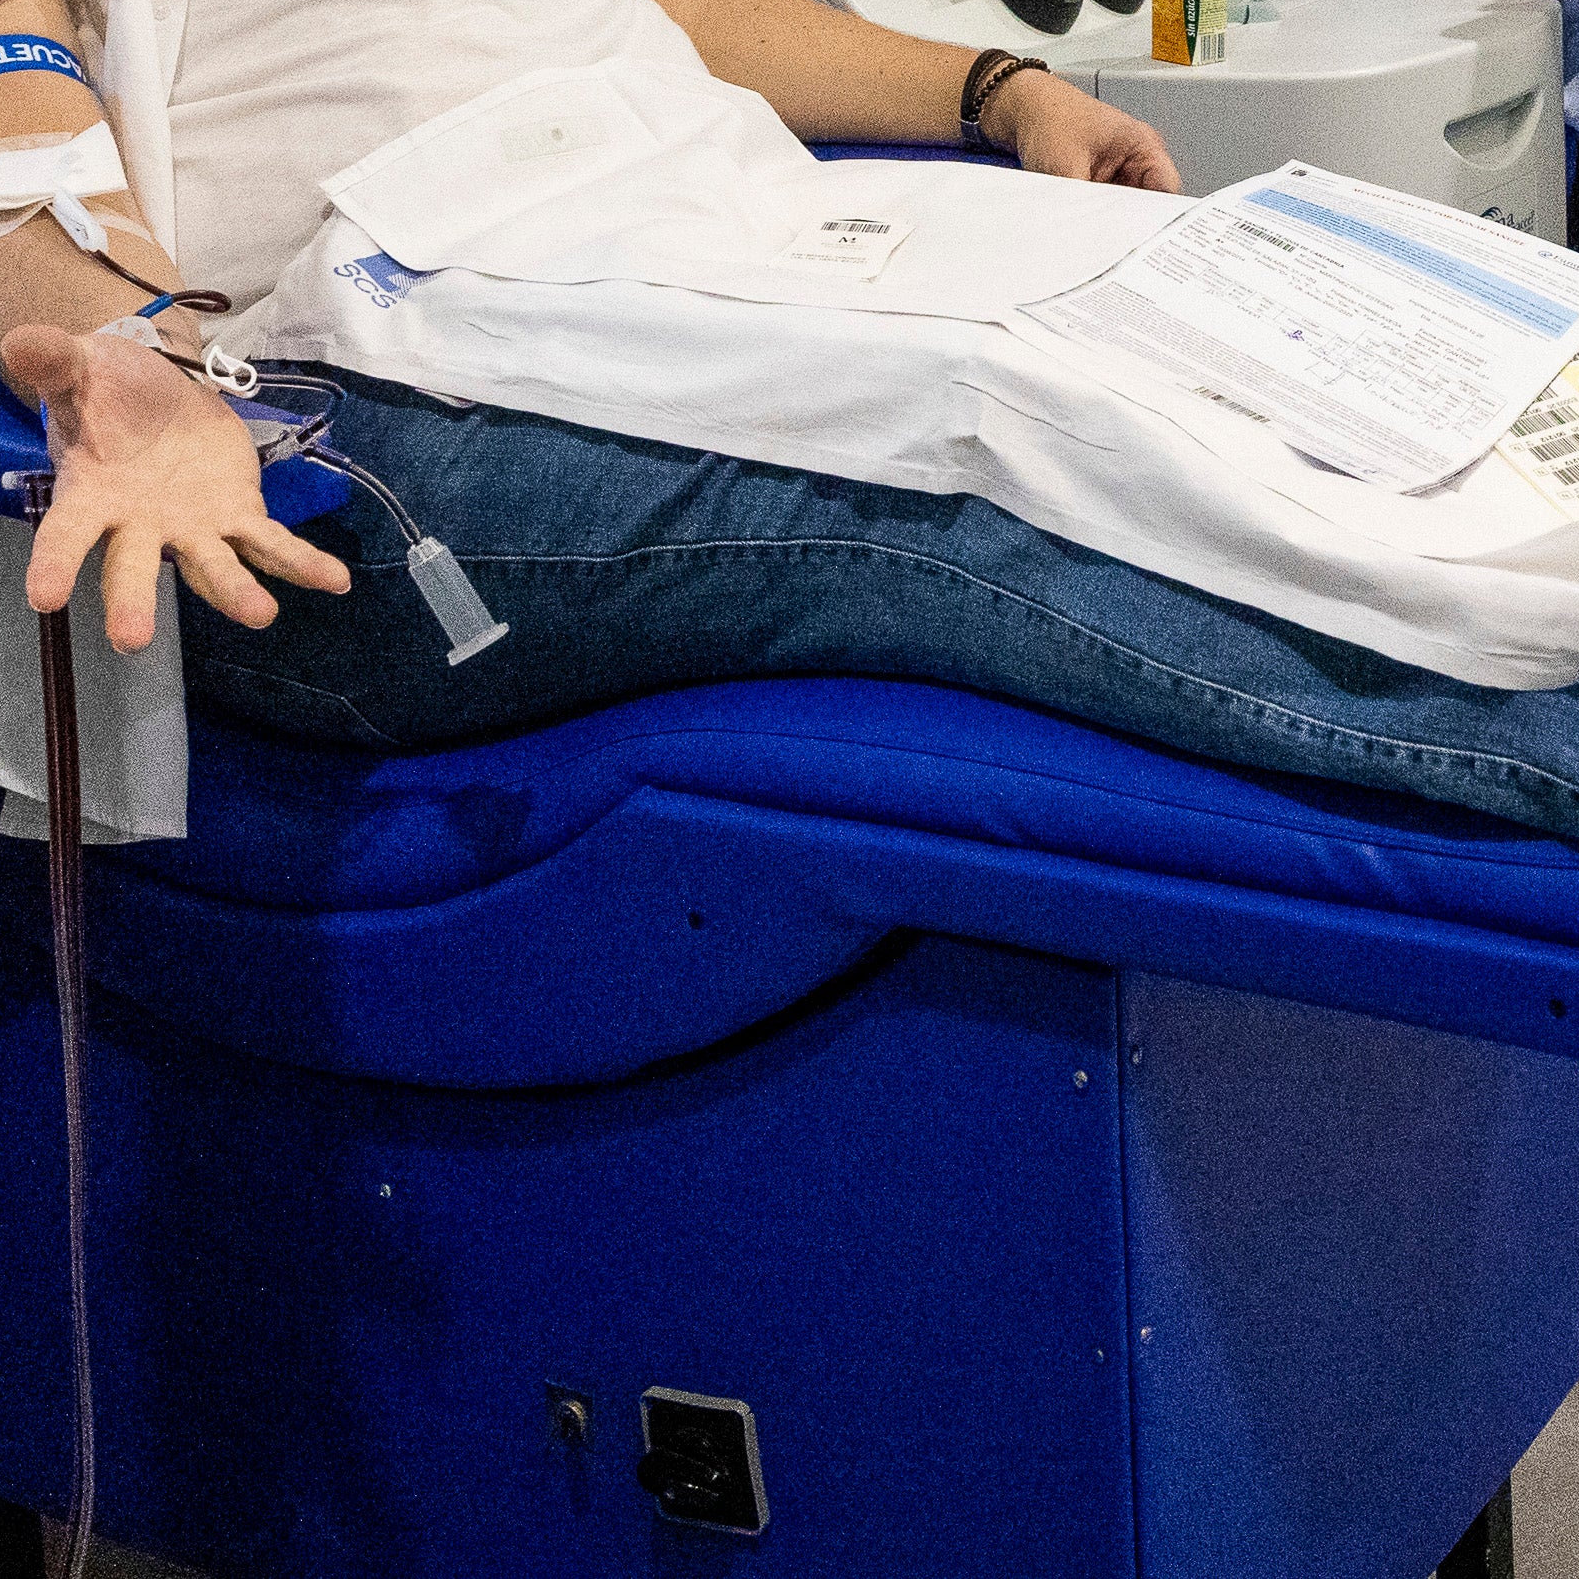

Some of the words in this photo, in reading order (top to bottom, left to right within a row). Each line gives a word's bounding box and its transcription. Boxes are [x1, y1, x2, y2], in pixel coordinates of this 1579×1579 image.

[1187, 23, 1197, 38] sin
[1211, 206, 1234, 217] BANCO
[1309, 250, 1346, 268] CANTABRIA
[1450, 216, 1489, 232] DONAR
[1486, 229, 1526, 246] SANGRE
[333, 263, 398, 309] SCS
[1540, 430, 1568, 443] 001212
